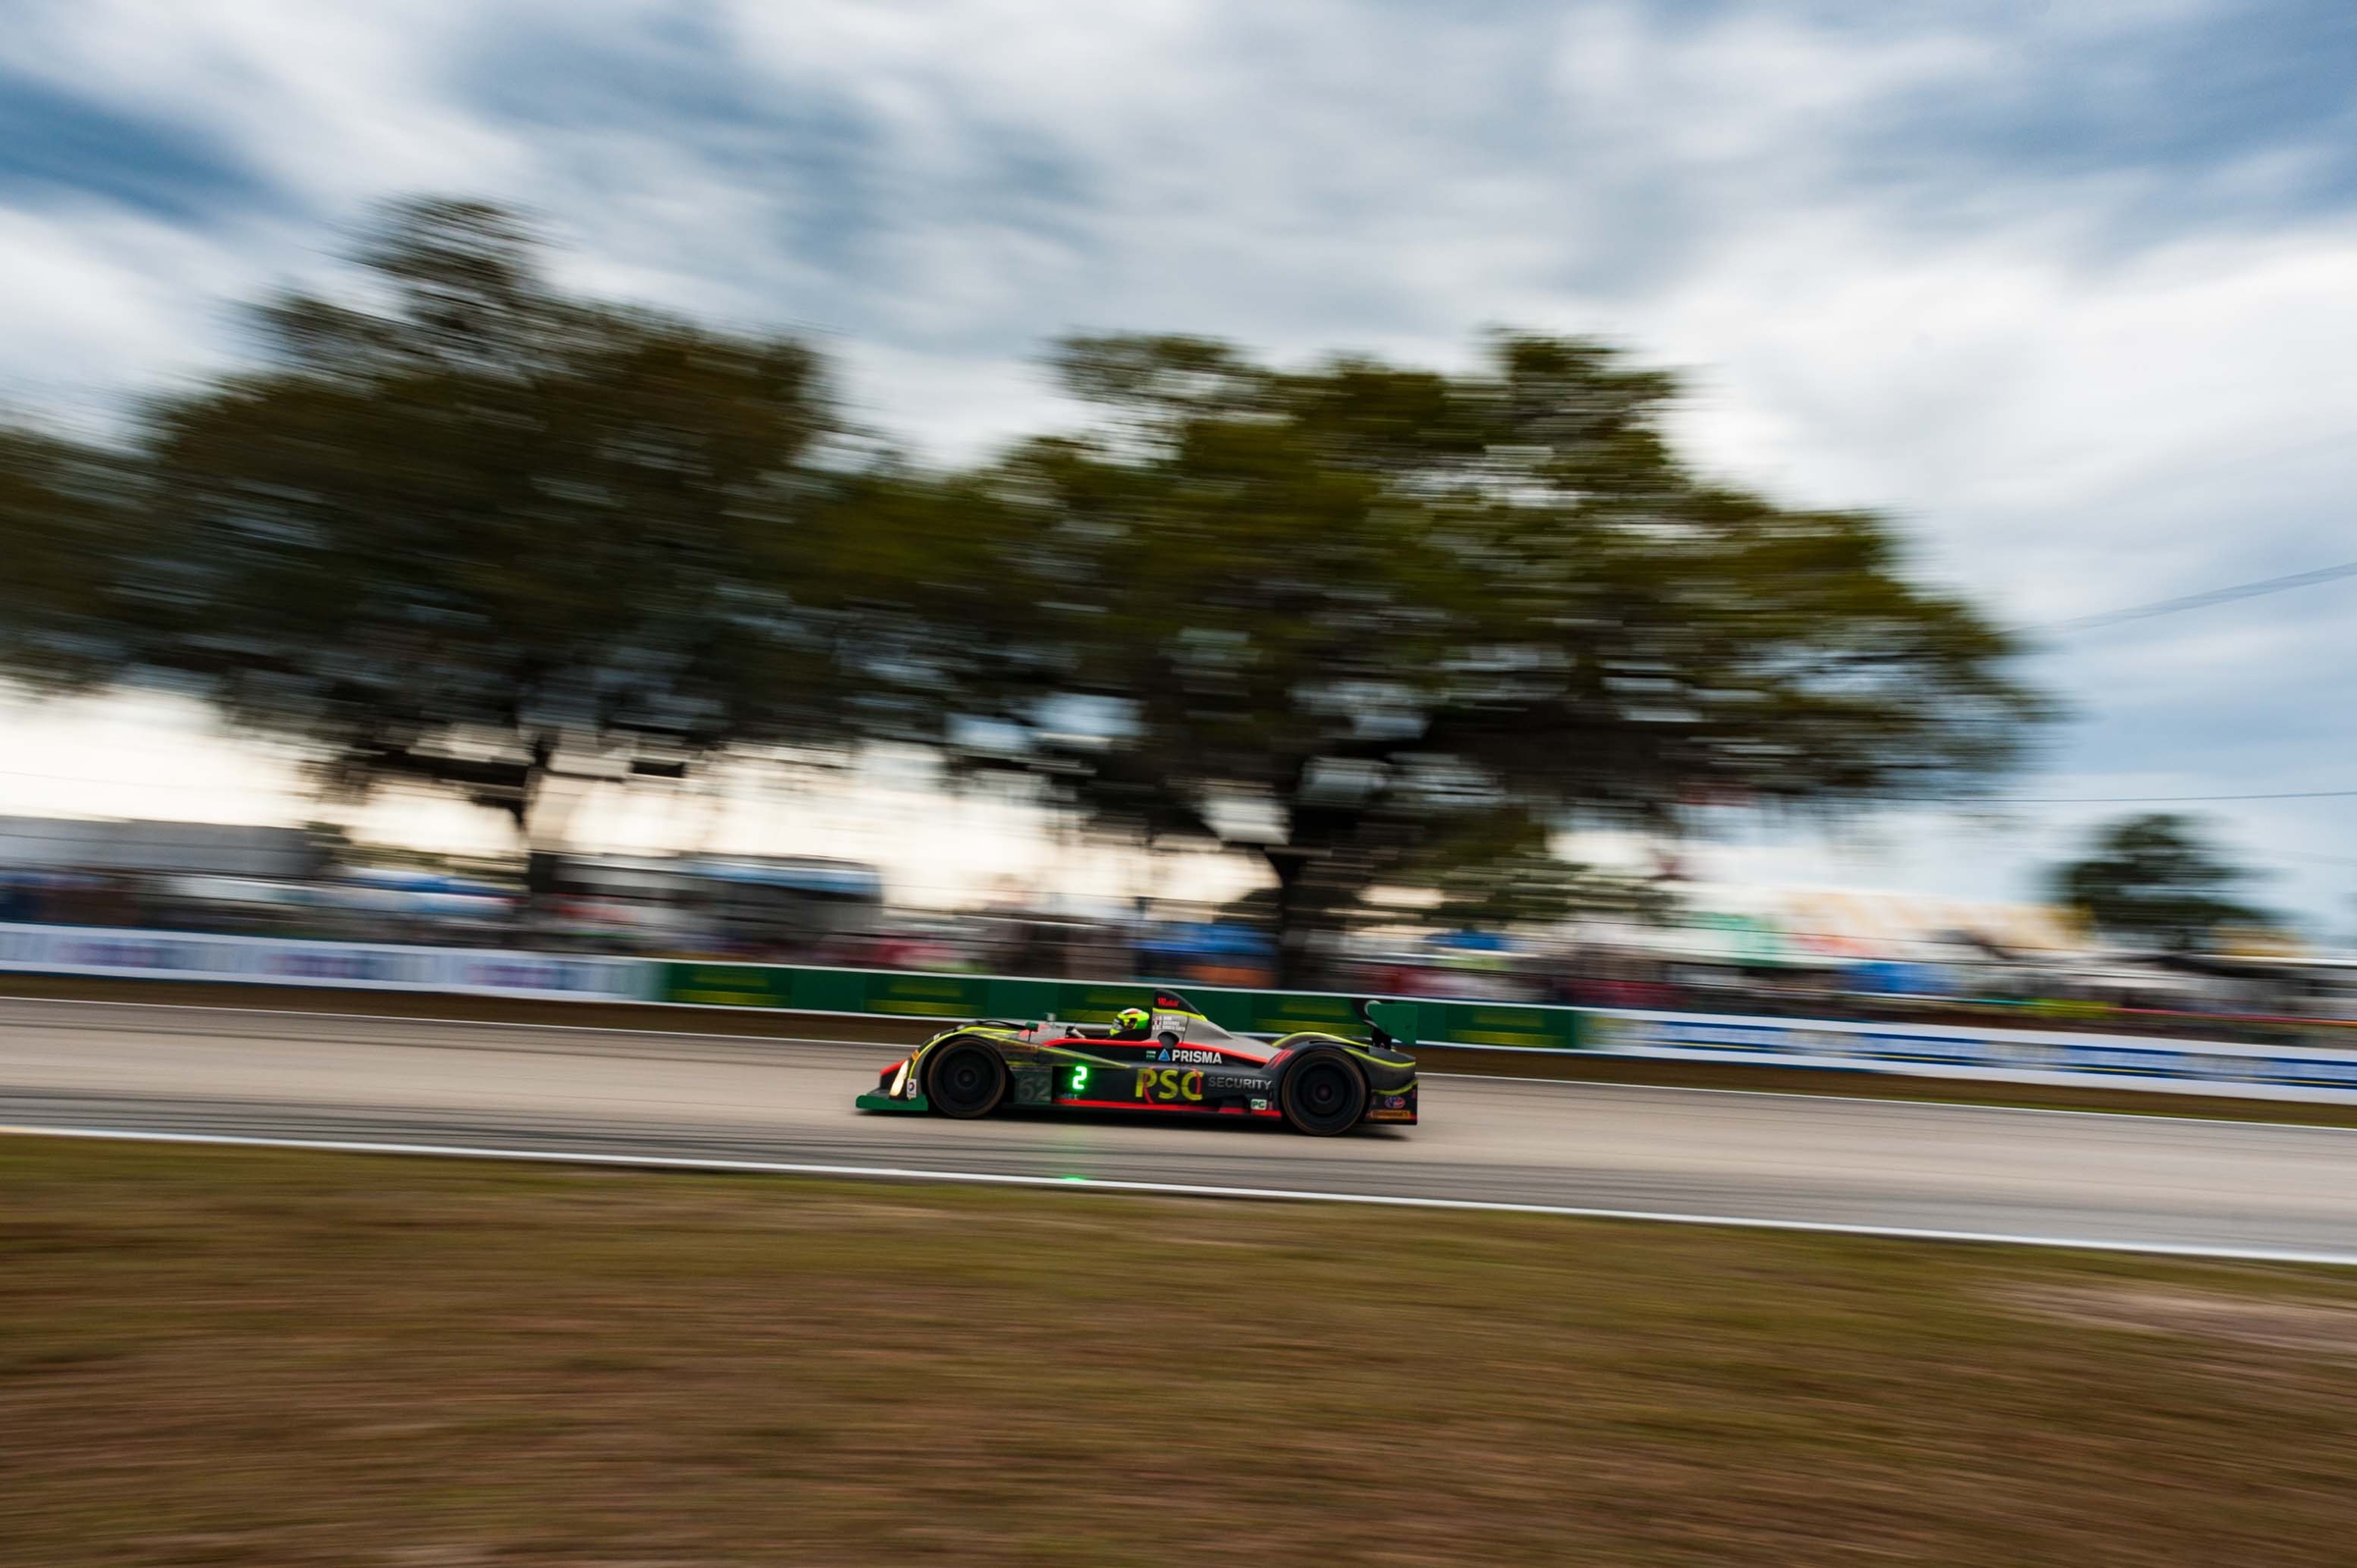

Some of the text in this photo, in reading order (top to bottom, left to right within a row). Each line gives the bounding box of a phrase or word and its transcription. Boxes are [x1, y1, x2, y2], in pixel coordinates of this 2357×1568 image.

[1172, 1050, 1223, 1064] PRISMA
[1072, 1065, 1088, 1090] 2
[1135, 1068, 1273, 1102] PSC SECURITY
